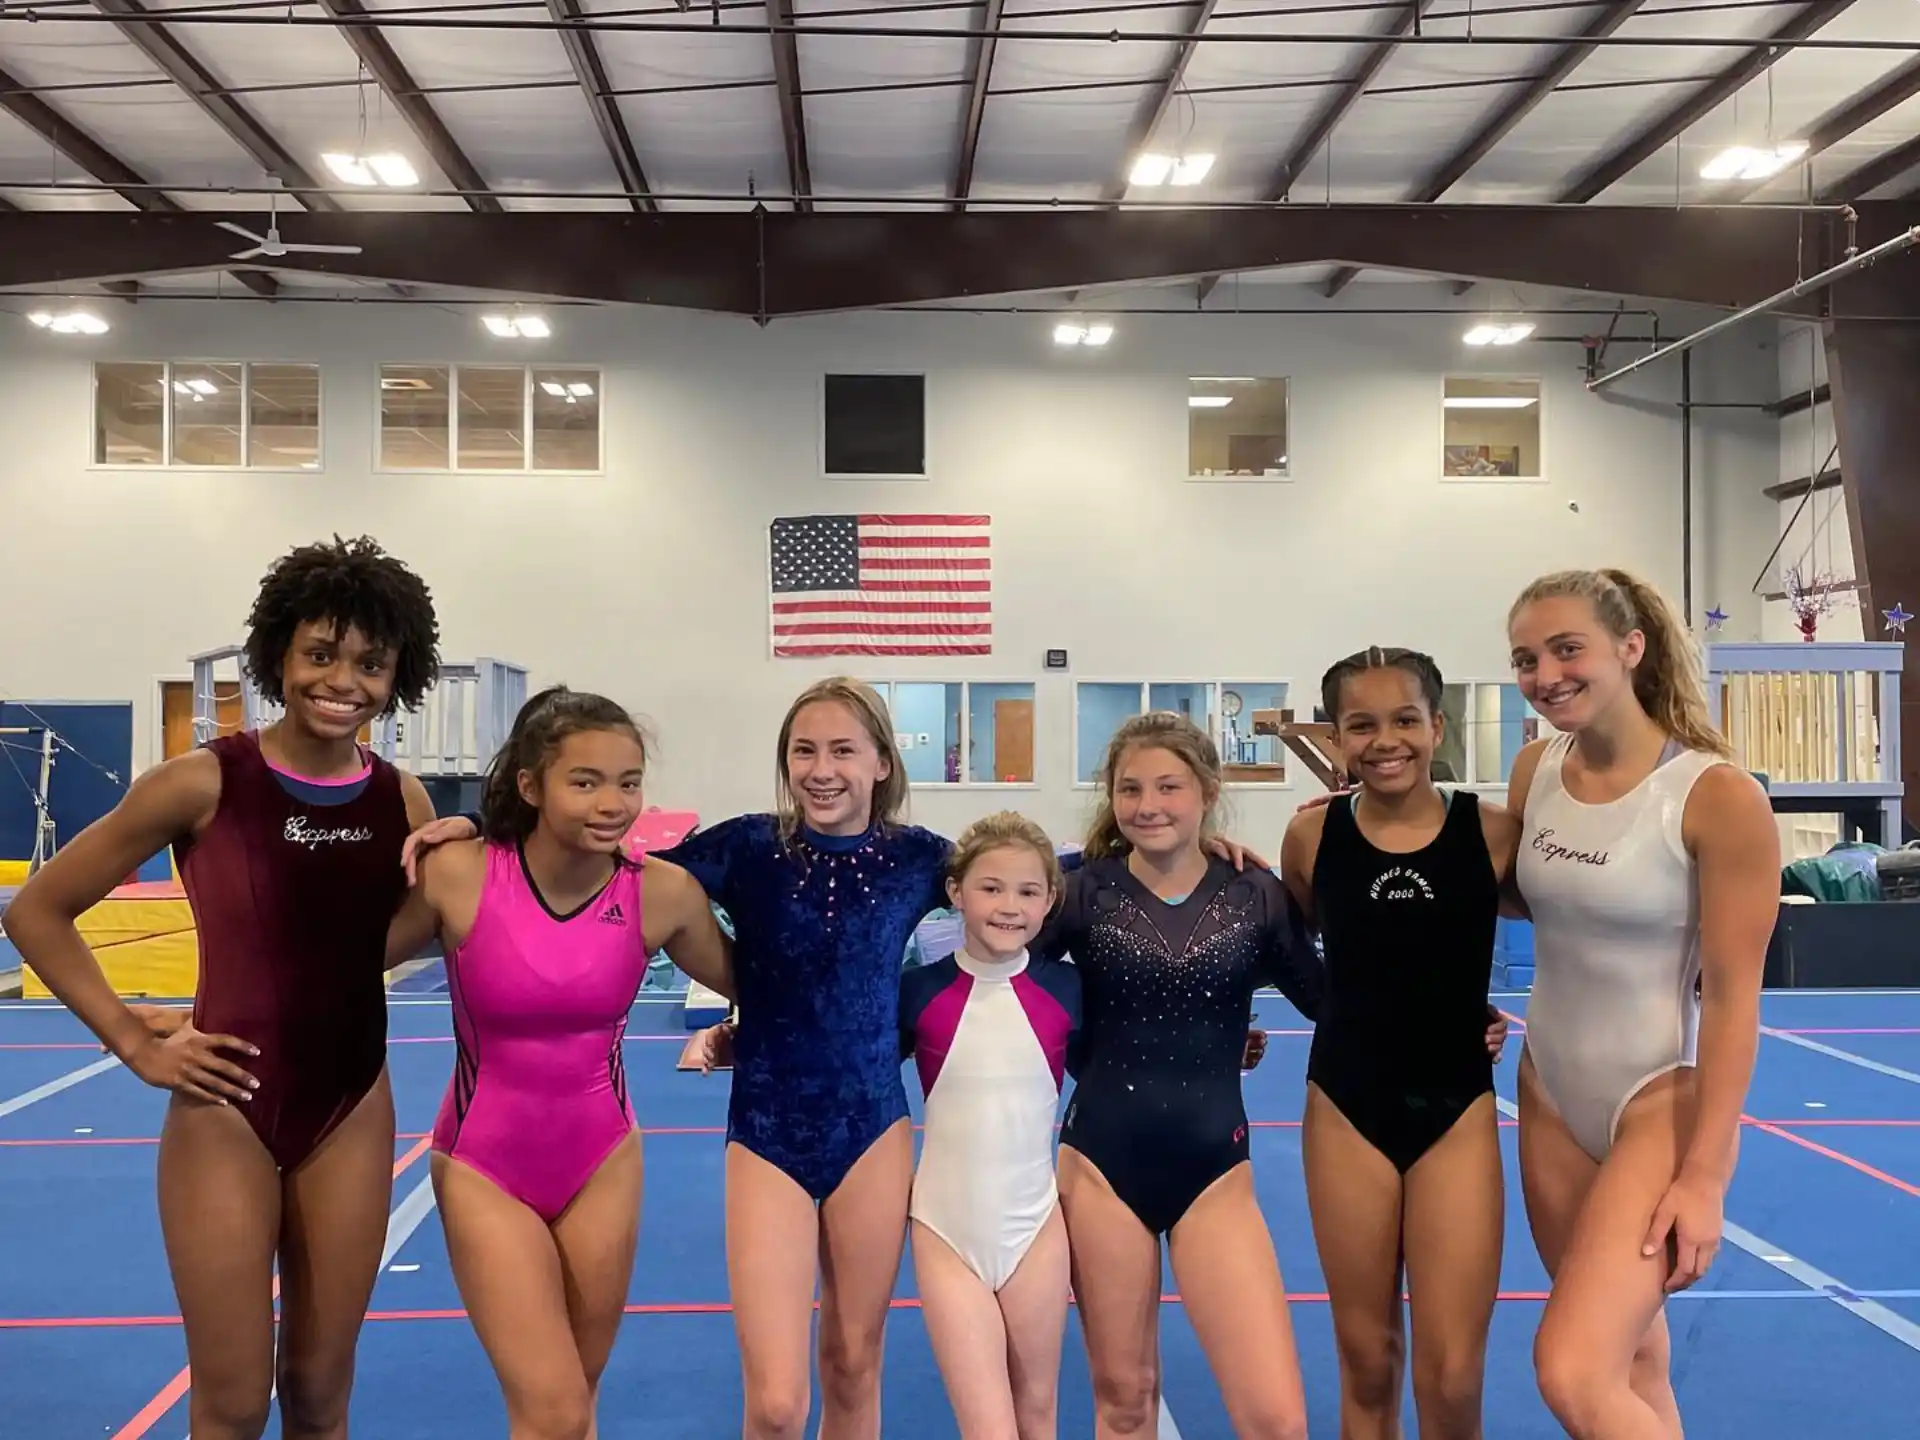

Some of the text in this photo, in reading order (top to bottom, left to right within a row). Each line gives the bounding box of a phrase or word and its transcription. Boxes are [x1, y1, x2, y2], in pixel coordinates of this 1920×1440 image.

[283, 815, 373, 851] Express
[1532, 827, 1611, 865] Express
[1387, 888, 1415, 900] 2000
[1404, 868, 1435, 900] GAMES
